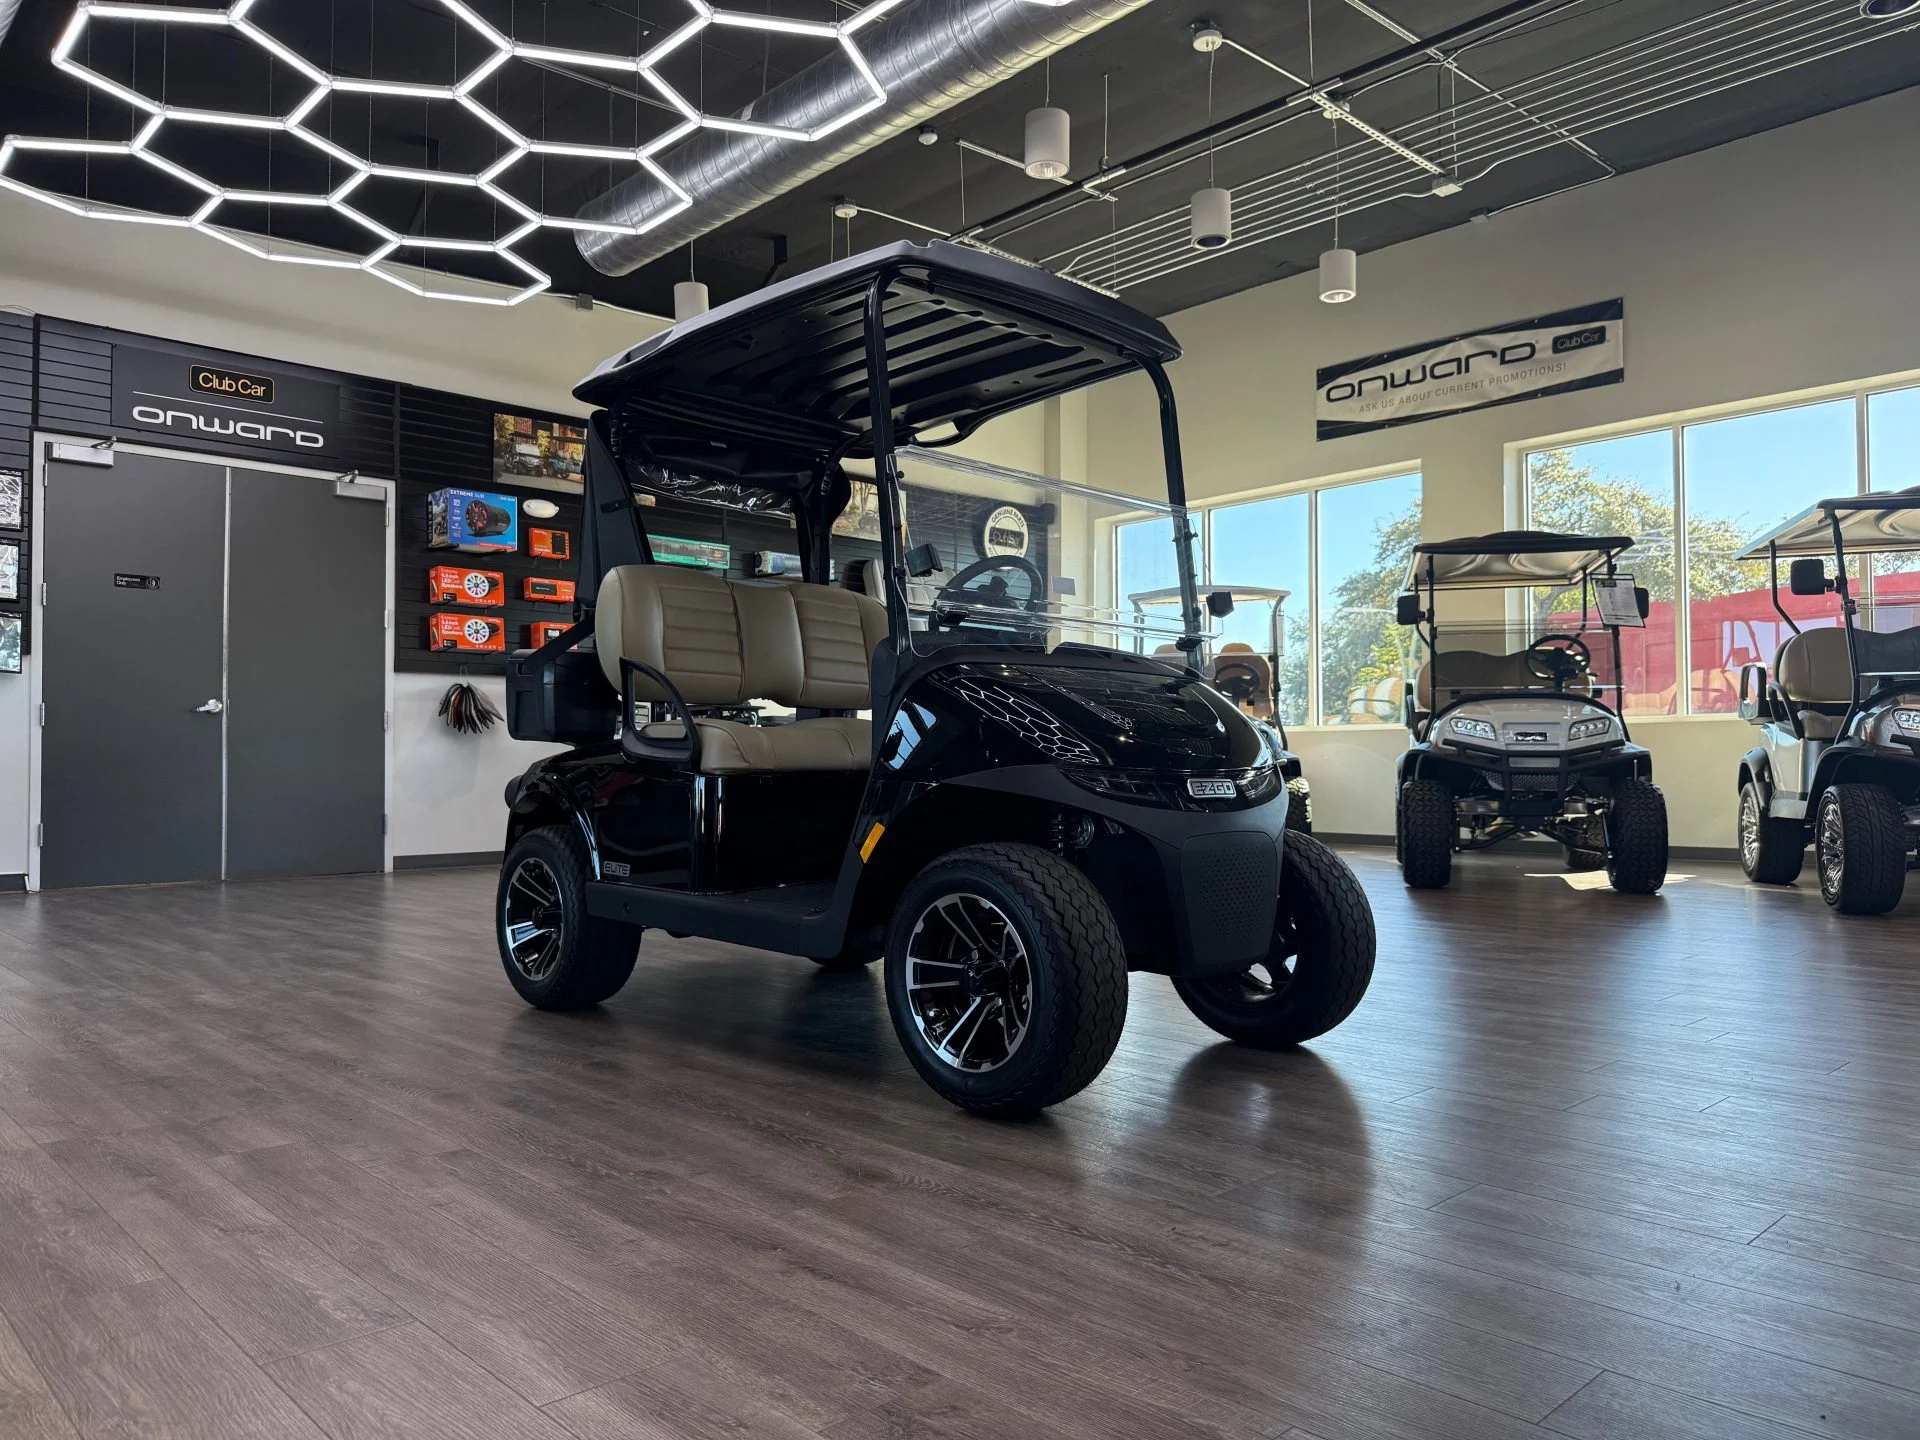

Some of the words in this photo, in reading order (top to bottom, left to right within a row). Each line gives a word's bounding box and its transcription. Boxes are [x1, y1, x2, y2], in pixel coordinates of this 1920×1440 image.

[198, 372, 236, 393] Club
[237, 378, 267, 398] Car
[1325, 341, 1536, 403] onward
[1557, 335, 1581, 350] Club
[1581, 330, 1601, 344] Car
[1358, 400, 1379, 413] ASK
[1381, 396, 1395, 409] US
[1398, 390, 1433, 406] ABOUT
[1434, 378, 1486, 397] CURRENT
[1488, 362, 1567, 385] PROMOTIONS!
[132, 406, 324, 448] onward
[605, 862, 629, 876] ELITE
